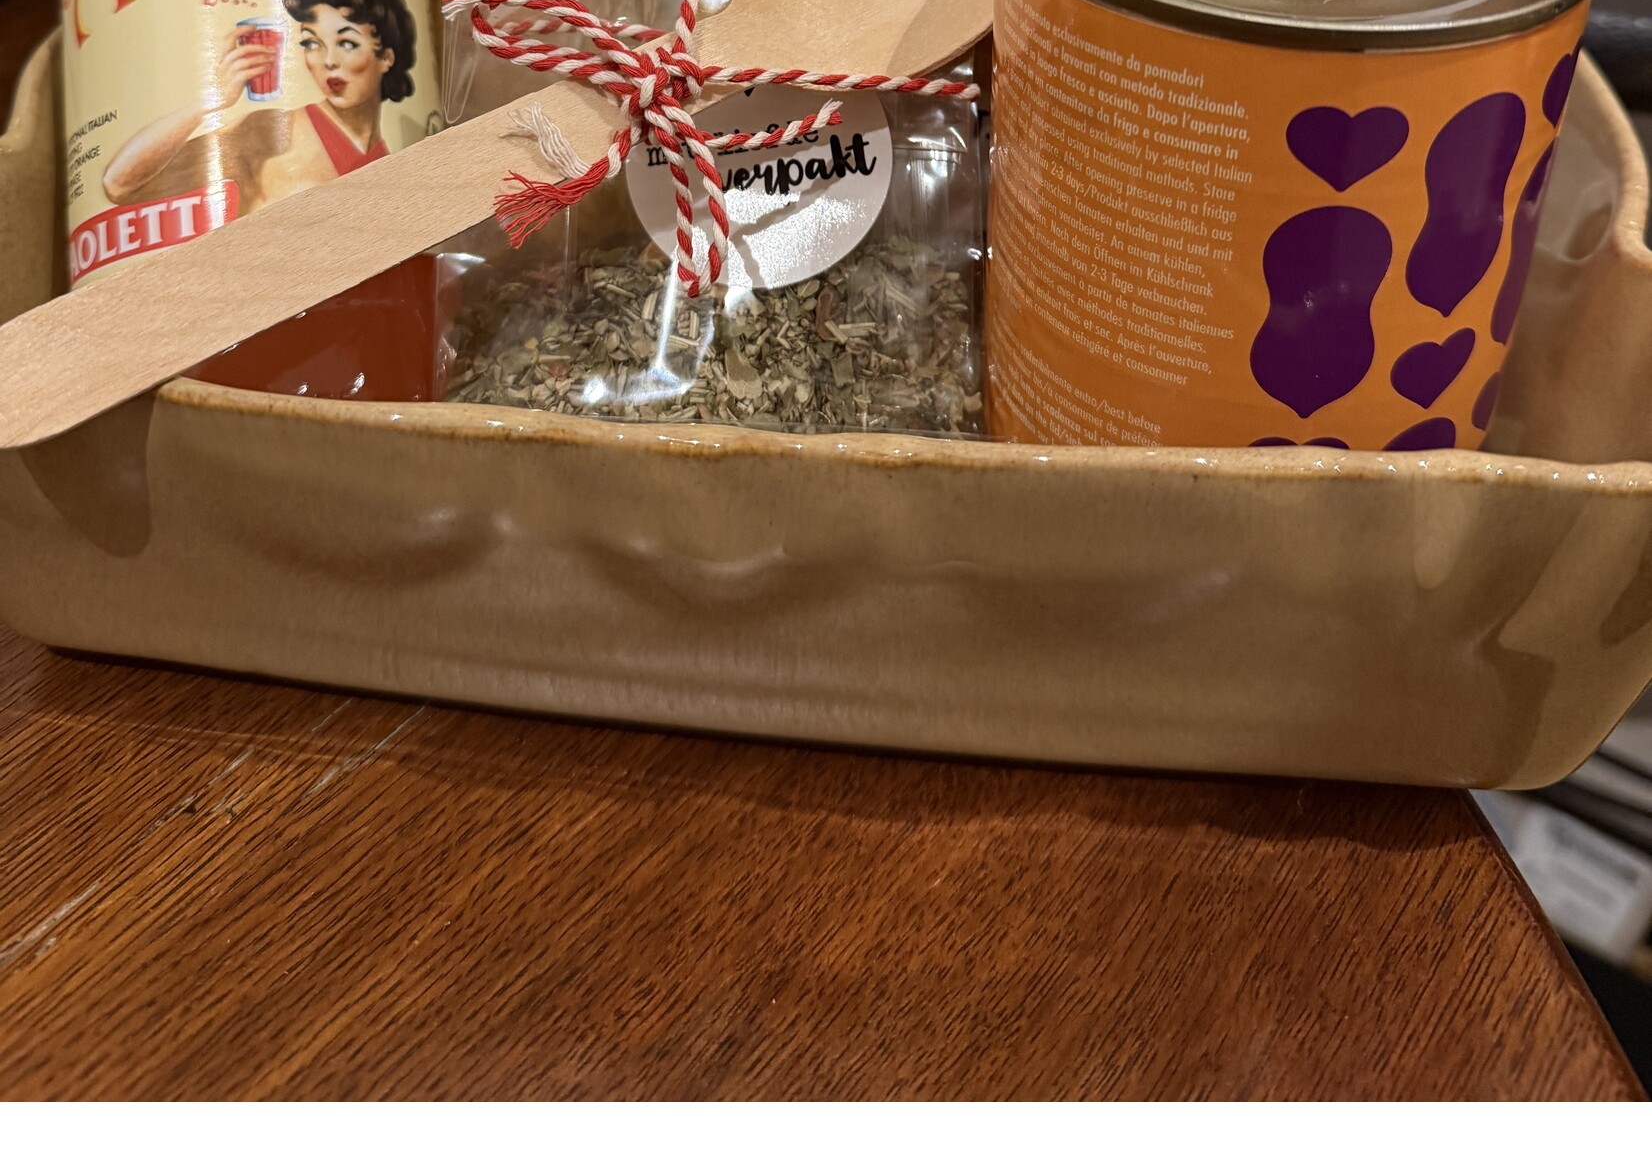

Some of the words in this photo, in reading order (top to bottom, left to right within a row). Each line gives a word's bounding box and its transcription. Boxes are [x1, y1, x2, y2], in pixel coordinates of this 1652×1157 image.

[1036, 50, 1058, 77] luogo
[1060, 66, 1086, 93] fresco
[1089, 86, 1096, 97] e
[1098, 89, 1142, 116] asciutto.
[1147, 102, 1178, 126] Dopo
[1052, 26, 1123, 65] esclusivamente
[1126, 53, 1141, 73] da
[1144, 63, 1205, 89] pomodori
[1061, 45, 1097, 76] lavorati
[1099, 69, 1117, 85] con
[1120, 80, 1164, 101] metodo
[1168, 90, 1249, 120] tradizionale.
[1045, 83, 1094, 117] contenitore
[1097, 107, 1110, 125] da
[1113, 112, 1139, 137] frigo
[1143, 128, 1150, 139] e
[1154, 131, 1222, 157] consumare
[1225, 143, 1238, 161] in
[1051, 106, 1087, 133] obtained
[1089, 127, 1142, 160] exclusively
[1145, 144, 1159, 165] by
[1162, 153, 1211, 176] selected
[1214, 163, 1253, 184] Italian
[1050, 160, 1065, 181] 2-3
[1131, 205, 1209, 237] ausschließlich
[1211, 228, 1234, 242] aus
[1063, 150, 1084, 172] After
[1085, 165, 1123, 194] opening
[1126, 184, 1173, 208] preserve
[1176, 197, 1187, 212] in
[1190, 203, 1199, 215] a
[1202, 200, 1238, 224] fridge
[1067, 135, 1090, 160] using
[1093, 146, 1143, 179] traditional
[1146, 169, 1198, 194] methods.
[1203, 182, 1236, 202] Store
[1050, 220, 1070, 244] Nach
[1071, 234, 1091, 255] dem
[1093, 242, 1127, 271] Öffnen
[1130, 261, 1143, 277] im
[1146, 266, 1214, 298] Kühlschrank
[1074, 195, 1112, 226] Tomaten
[1115, 219, 1158, 244] erhalten
[1161, 235, 1184, 251] und
[1187, 243, 1210, 258] und
[1213, 246, 1233, 262] mit
[1110, 235, 1125, 252] An
[1127, 243, 1161, 264] einem
[1163, 253, 1206, 279] kühlen,
[1056, 284, 1075, 304] avec
[1077, 295, 1123, 327] méthodes
[1126, 318, 1207, 354] traditionnelles.
[1072, 256, 1088, 273] von
[1090, 264, 1107, 282] 2-3
[1111, 273, 1134, 294] Tage
[1137, 286, 1207, 316] verbrauchen.
[1087, 284, 1113, 304] partir
[1115, 294, 1128, 310] de
[1131, 301, 1175, 326] tomates
[1178, 316, 1235, 340] italiennes
[1062, 302, 1081, 325] frais
[1083, 318, 1093, 331] et
[1095, 324, 1114, 342] sec.
[1117, 332, 1146, 355] Après
[1072, 330, 1110, 358] réfrigéré
[1112, 352, 1123, 364] et
[1125, 356, 1189, 385] consommer
[1054, 392, 1103, 428] consommer
[1105, 421, 1118, 435] de
[1083, 427, 1098, 442] sul
[1127, 410, 1161, 434] before
